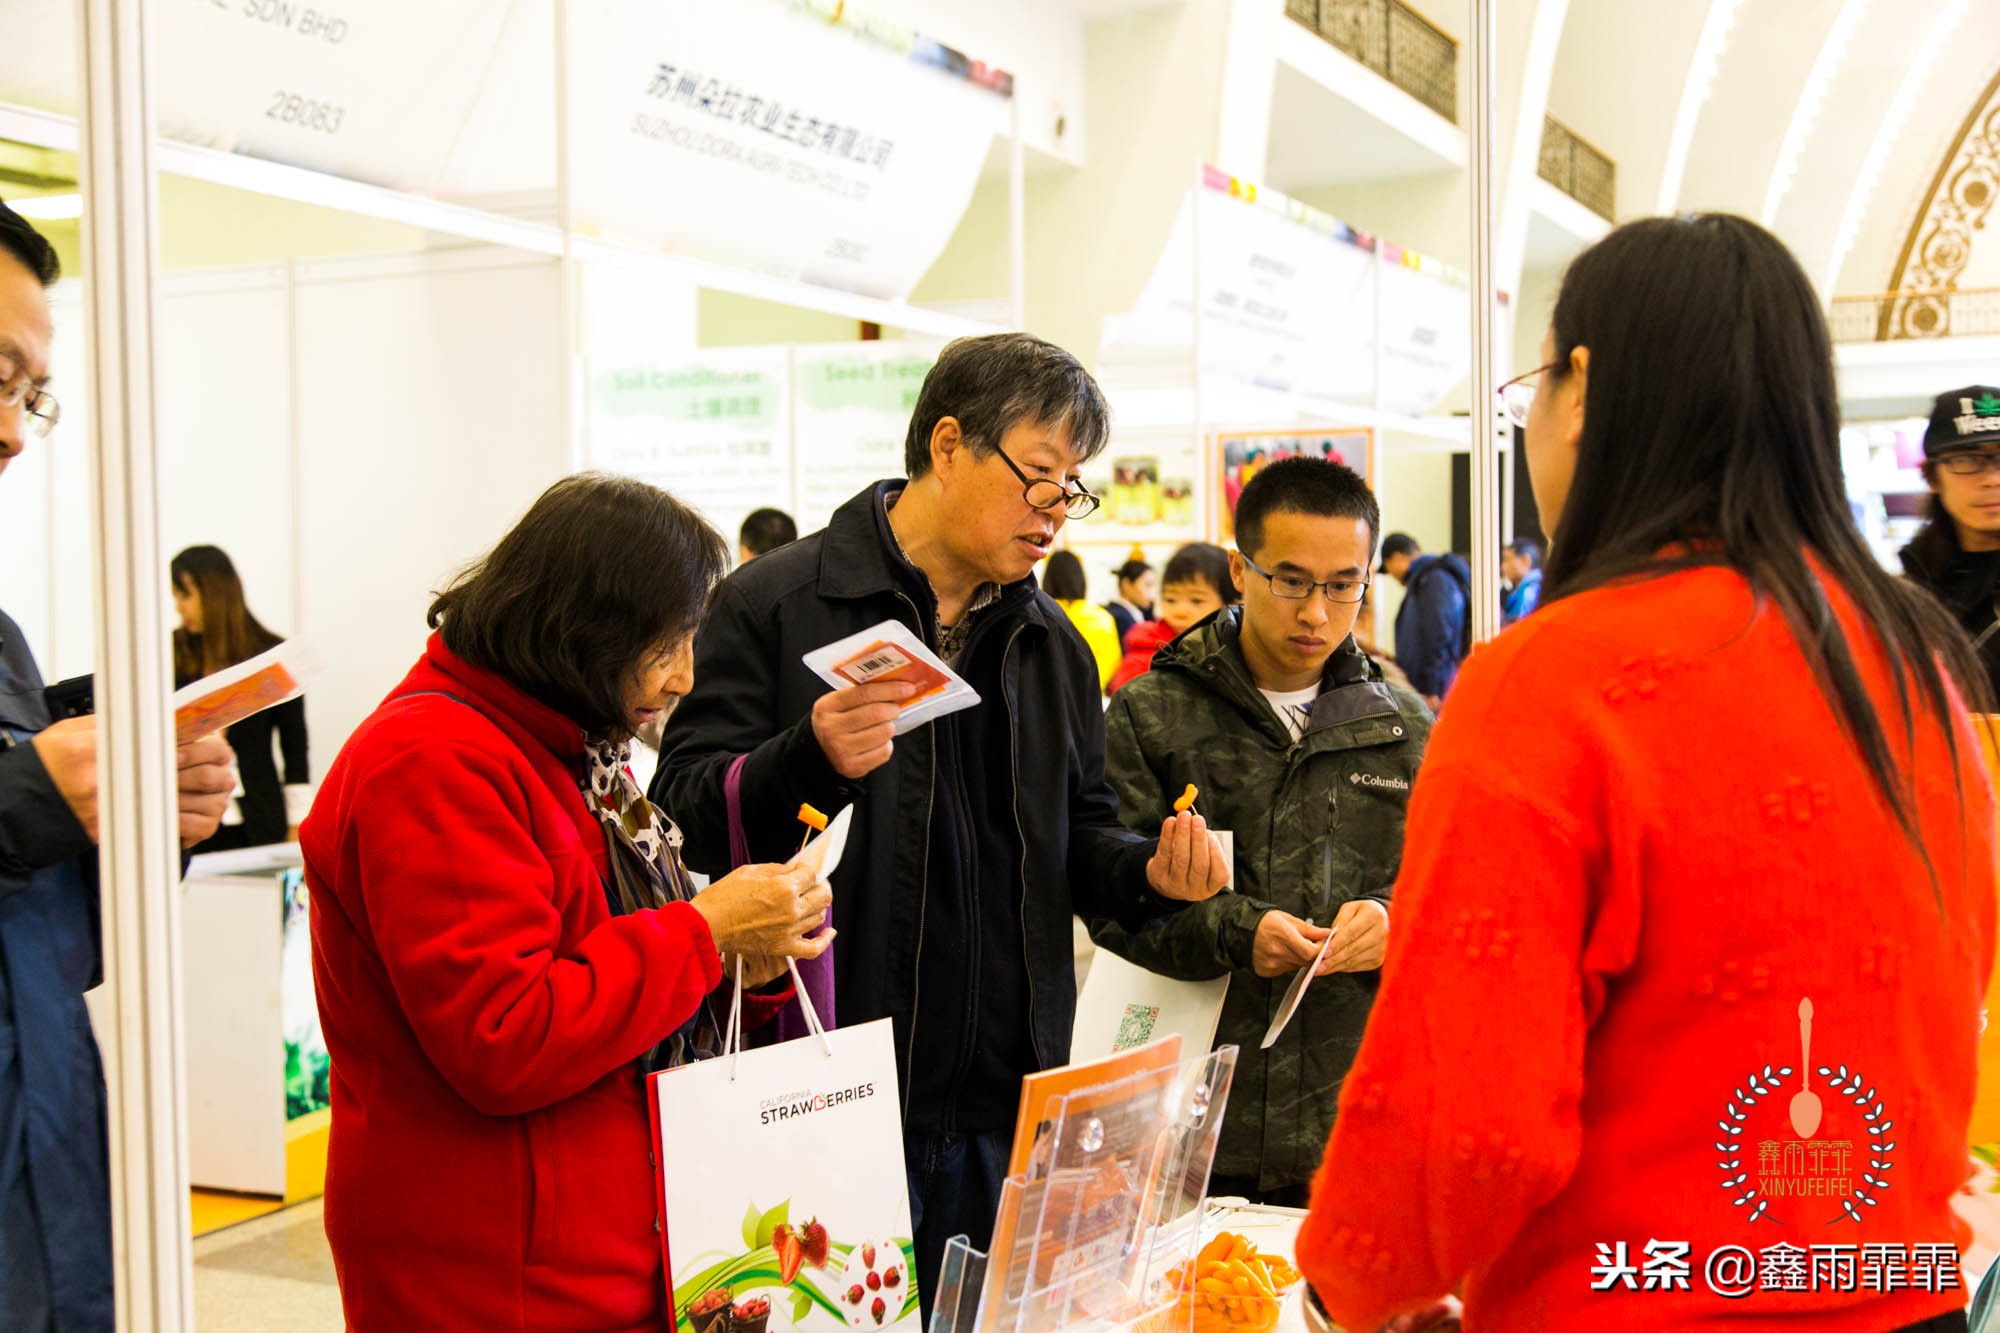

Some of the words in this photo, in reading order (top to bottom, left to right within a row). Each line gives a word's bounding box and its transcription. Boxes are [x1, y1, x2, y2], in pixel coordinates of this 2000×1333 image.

[645, 62, 894, 171] 苏州朵拉农业生态有限公司
[825, 361, 875, 382] Seed
[1361, 773, 1409, 790] Columbia
[759, 1088, 812, 1110] CALIFORNIA
[760, 1082, 875, 1125] STRAWBERRIES
